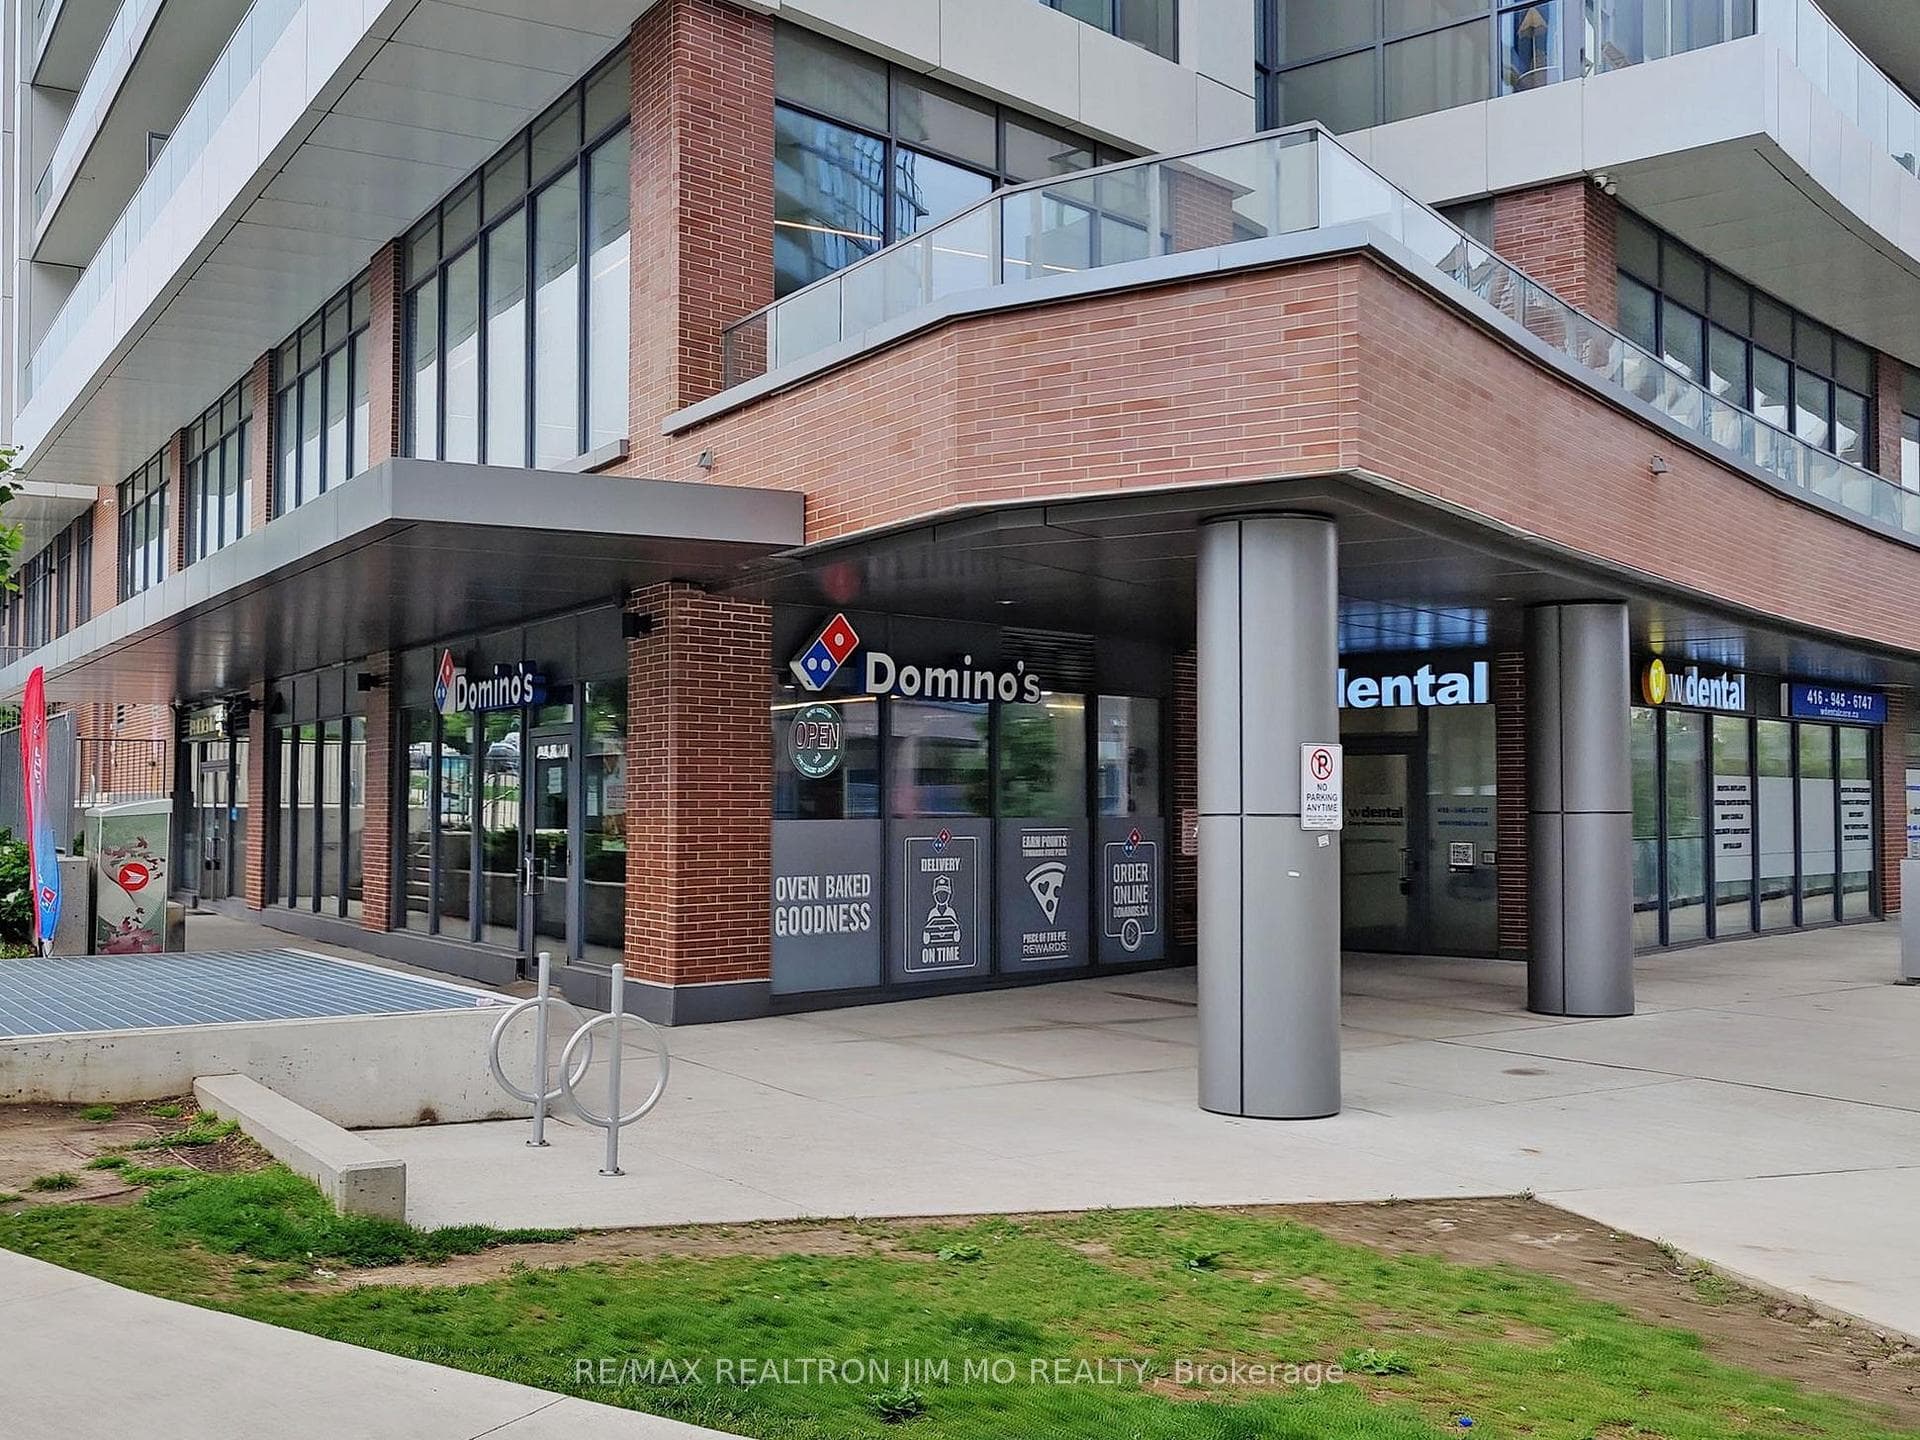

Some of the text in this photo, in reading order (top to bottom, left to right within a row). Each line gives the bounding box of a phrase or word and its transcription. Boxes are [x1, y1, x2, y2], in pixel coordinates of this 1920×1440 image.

[866, 651, 1041, 702] Domino's
[456, 662, 534, 712] Domino's
[1669, 666, 1746, 711] wdental
[1807, 689, 1823, 704] 416
[1830, 691, 1846, 707] 945
[1852, 694, 1873, 709] 6747
[796, 720, 840, 750] OPEN
[1306, 793, 1338, 803] PARKING
[1317, 783, 1328, 793] NO
[1307, 803, 1338, 813] ANYTIME
[1347, 806, 1404, 819] wdental
[920, 857, 961, 872] DELIVERY
[1113, 863, 1149, 883] ORDER
[775, 874, 871, 902] OVEN BAKED
[1113, 885, 1149, 905] ONLINE
[775, 902, 871, 937] GOODNESS
[921, 946, 960, 964] ON TIME
[1022, 942, 1067, 954] REWARDS
